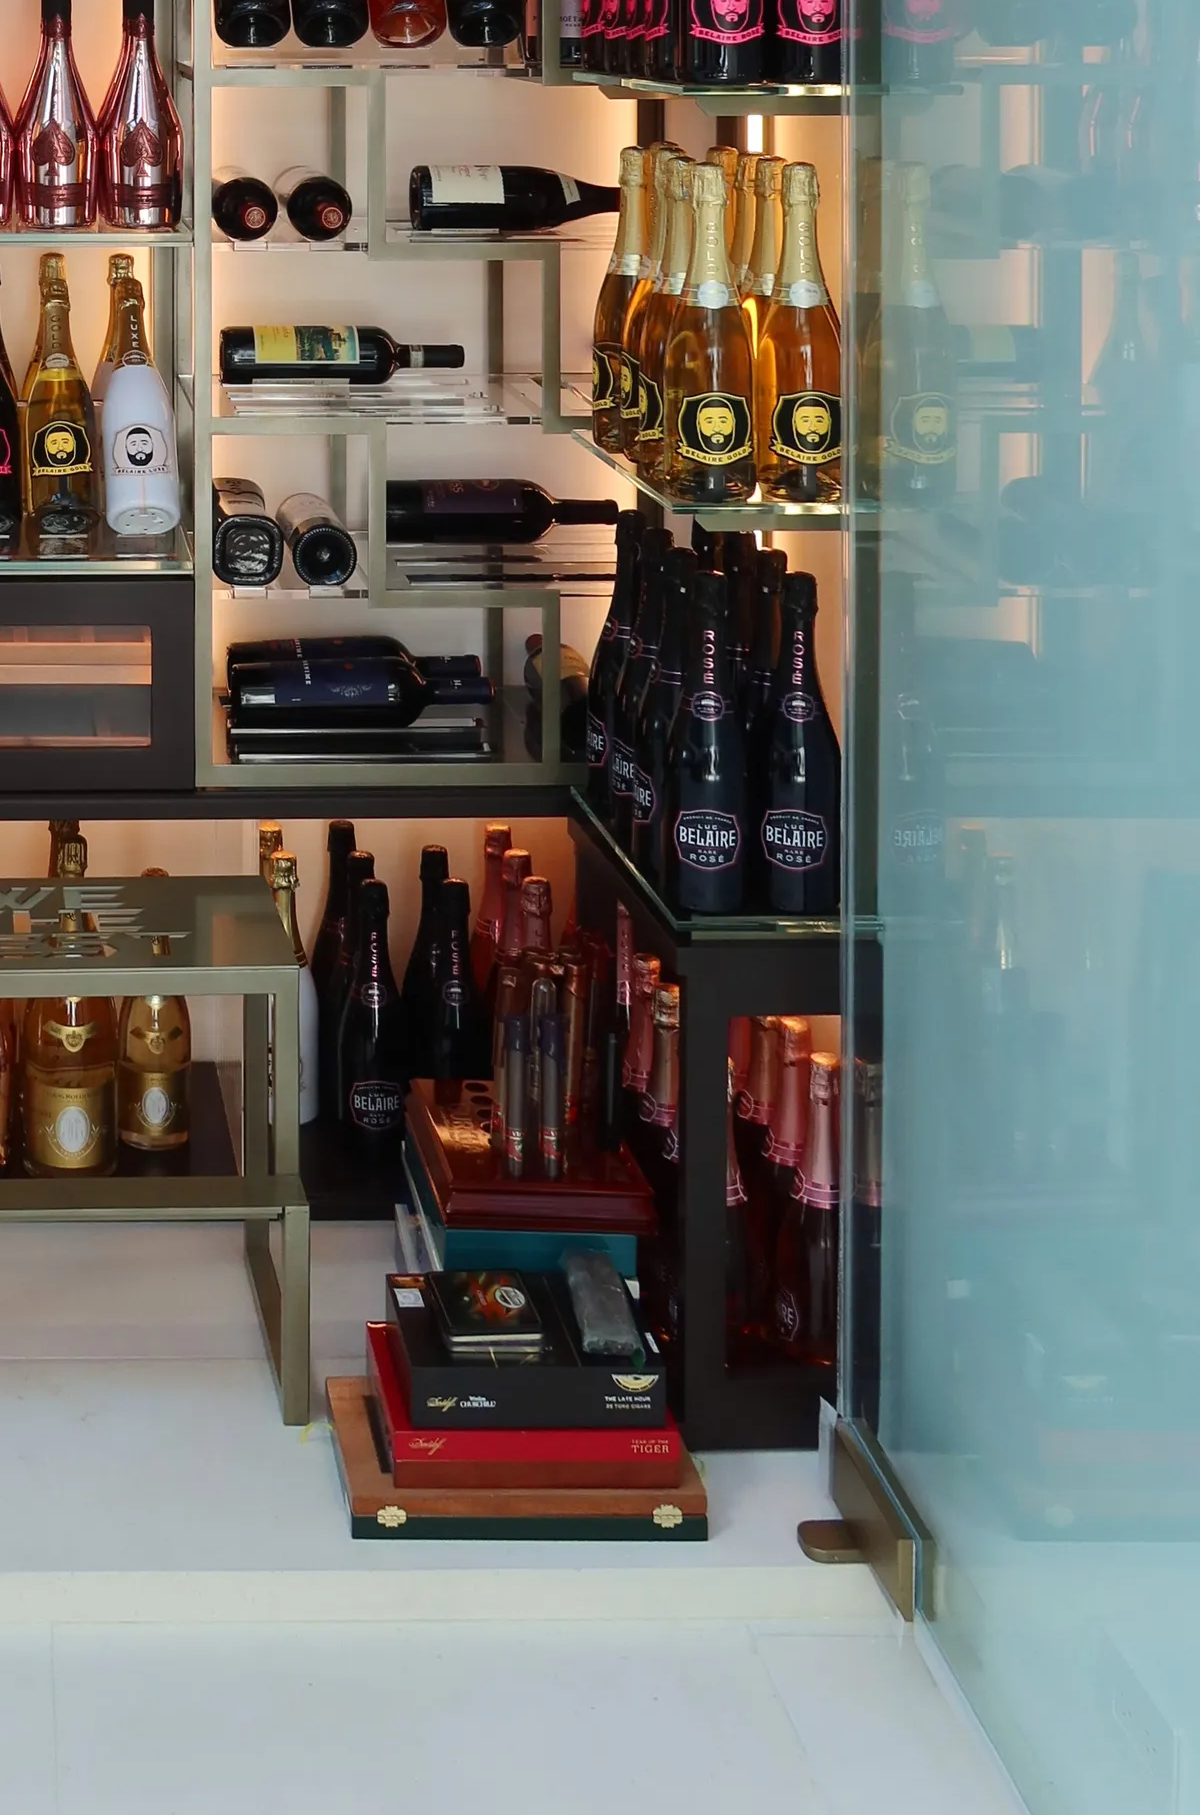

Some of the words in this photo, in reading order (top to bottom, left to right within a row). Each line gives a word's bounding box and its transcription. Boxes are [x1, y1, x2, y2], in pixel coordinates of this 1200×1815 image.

[698, 28, 738, 42] BELAIRE
[785, 29, 824, 42] BELAIRE
[130, 315, 139, 348] LUXE
[685, 448, 724, 463] BELAIRE
[726, 448, 748, 462] GOLD
[779, 447, 818, 462] BELAIRE
[69, 465, 88, 473] GOLD
[679, 826, 736, 849] BELAIRE
[765, 825, 823, 849] BELAIRE
[689, 853, 725, 864] ROSÉ
[776, 853, 812, 864] ROSÉ
[354, 1094, 400, 1111] BELAIRE
[631, 1444, 669, 1454] TIGER
